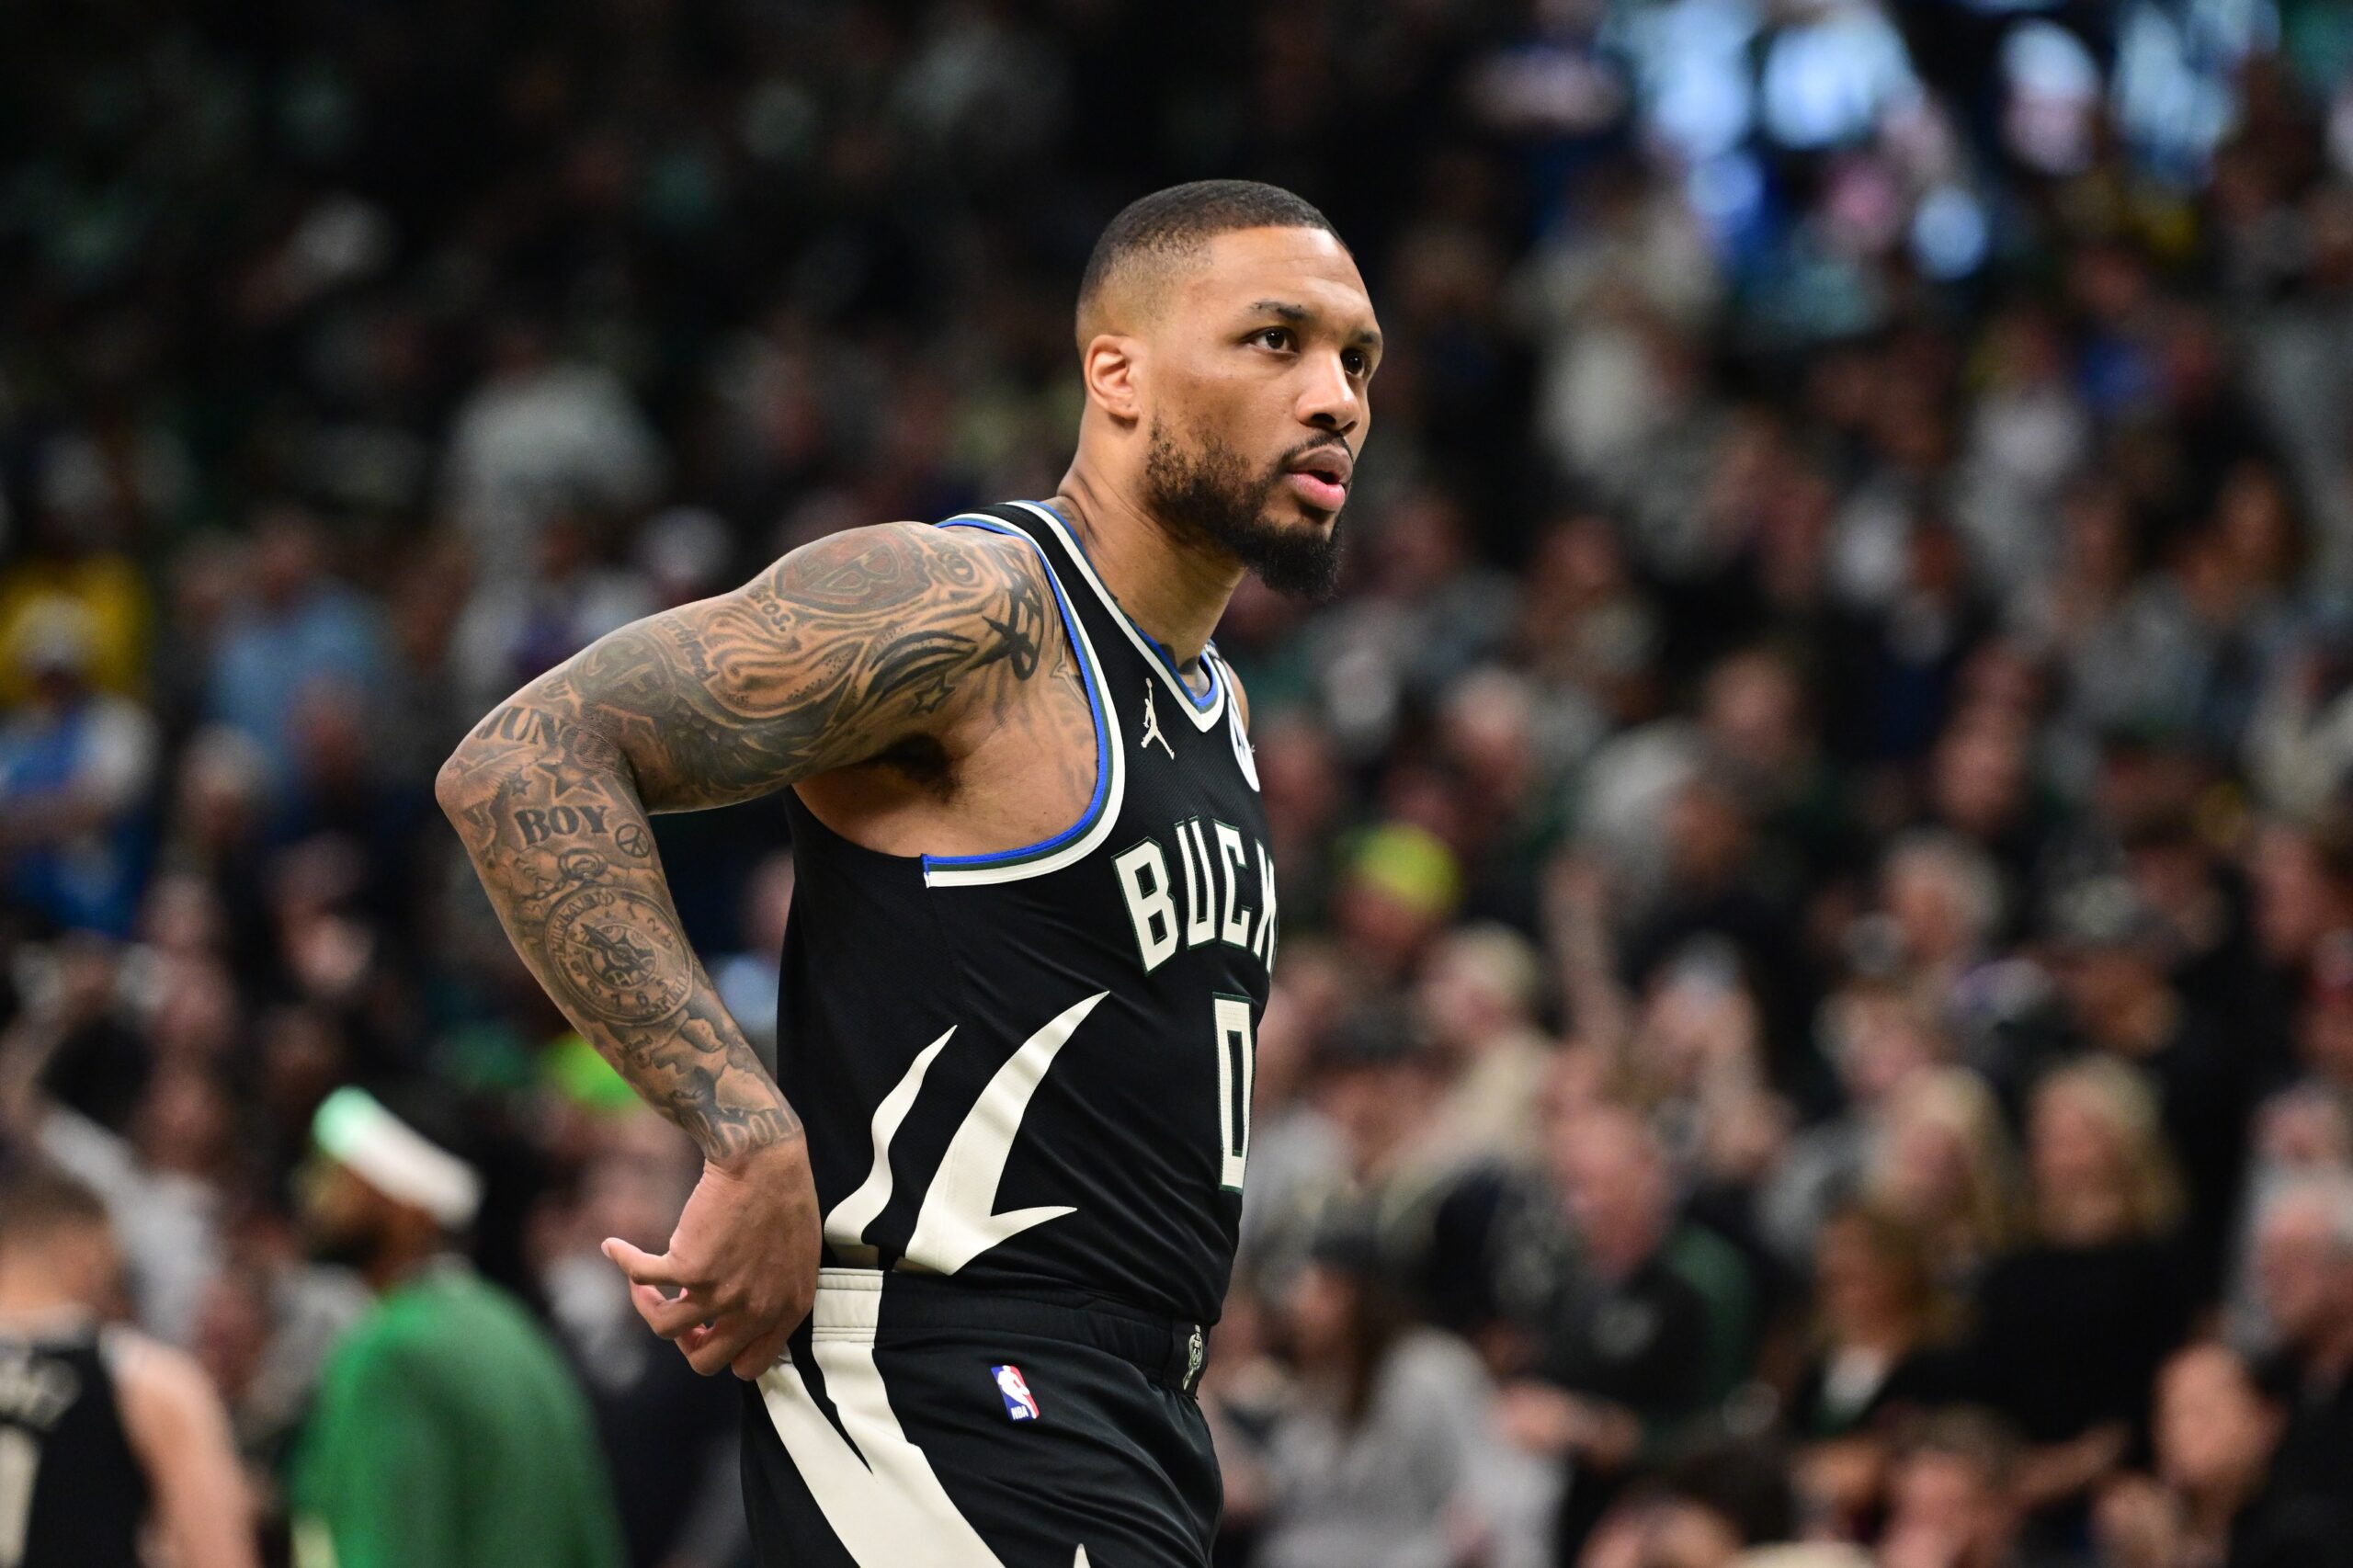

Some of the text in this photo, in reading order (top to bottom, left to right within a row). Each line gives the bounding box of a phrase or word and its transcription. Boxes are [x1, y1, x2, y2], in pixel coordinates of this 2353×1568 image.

[514, 805, 608, 845] BOY
[1212, 992, 1256, 1195] 0
[1011, 1405, 1029, 1420] NBA
